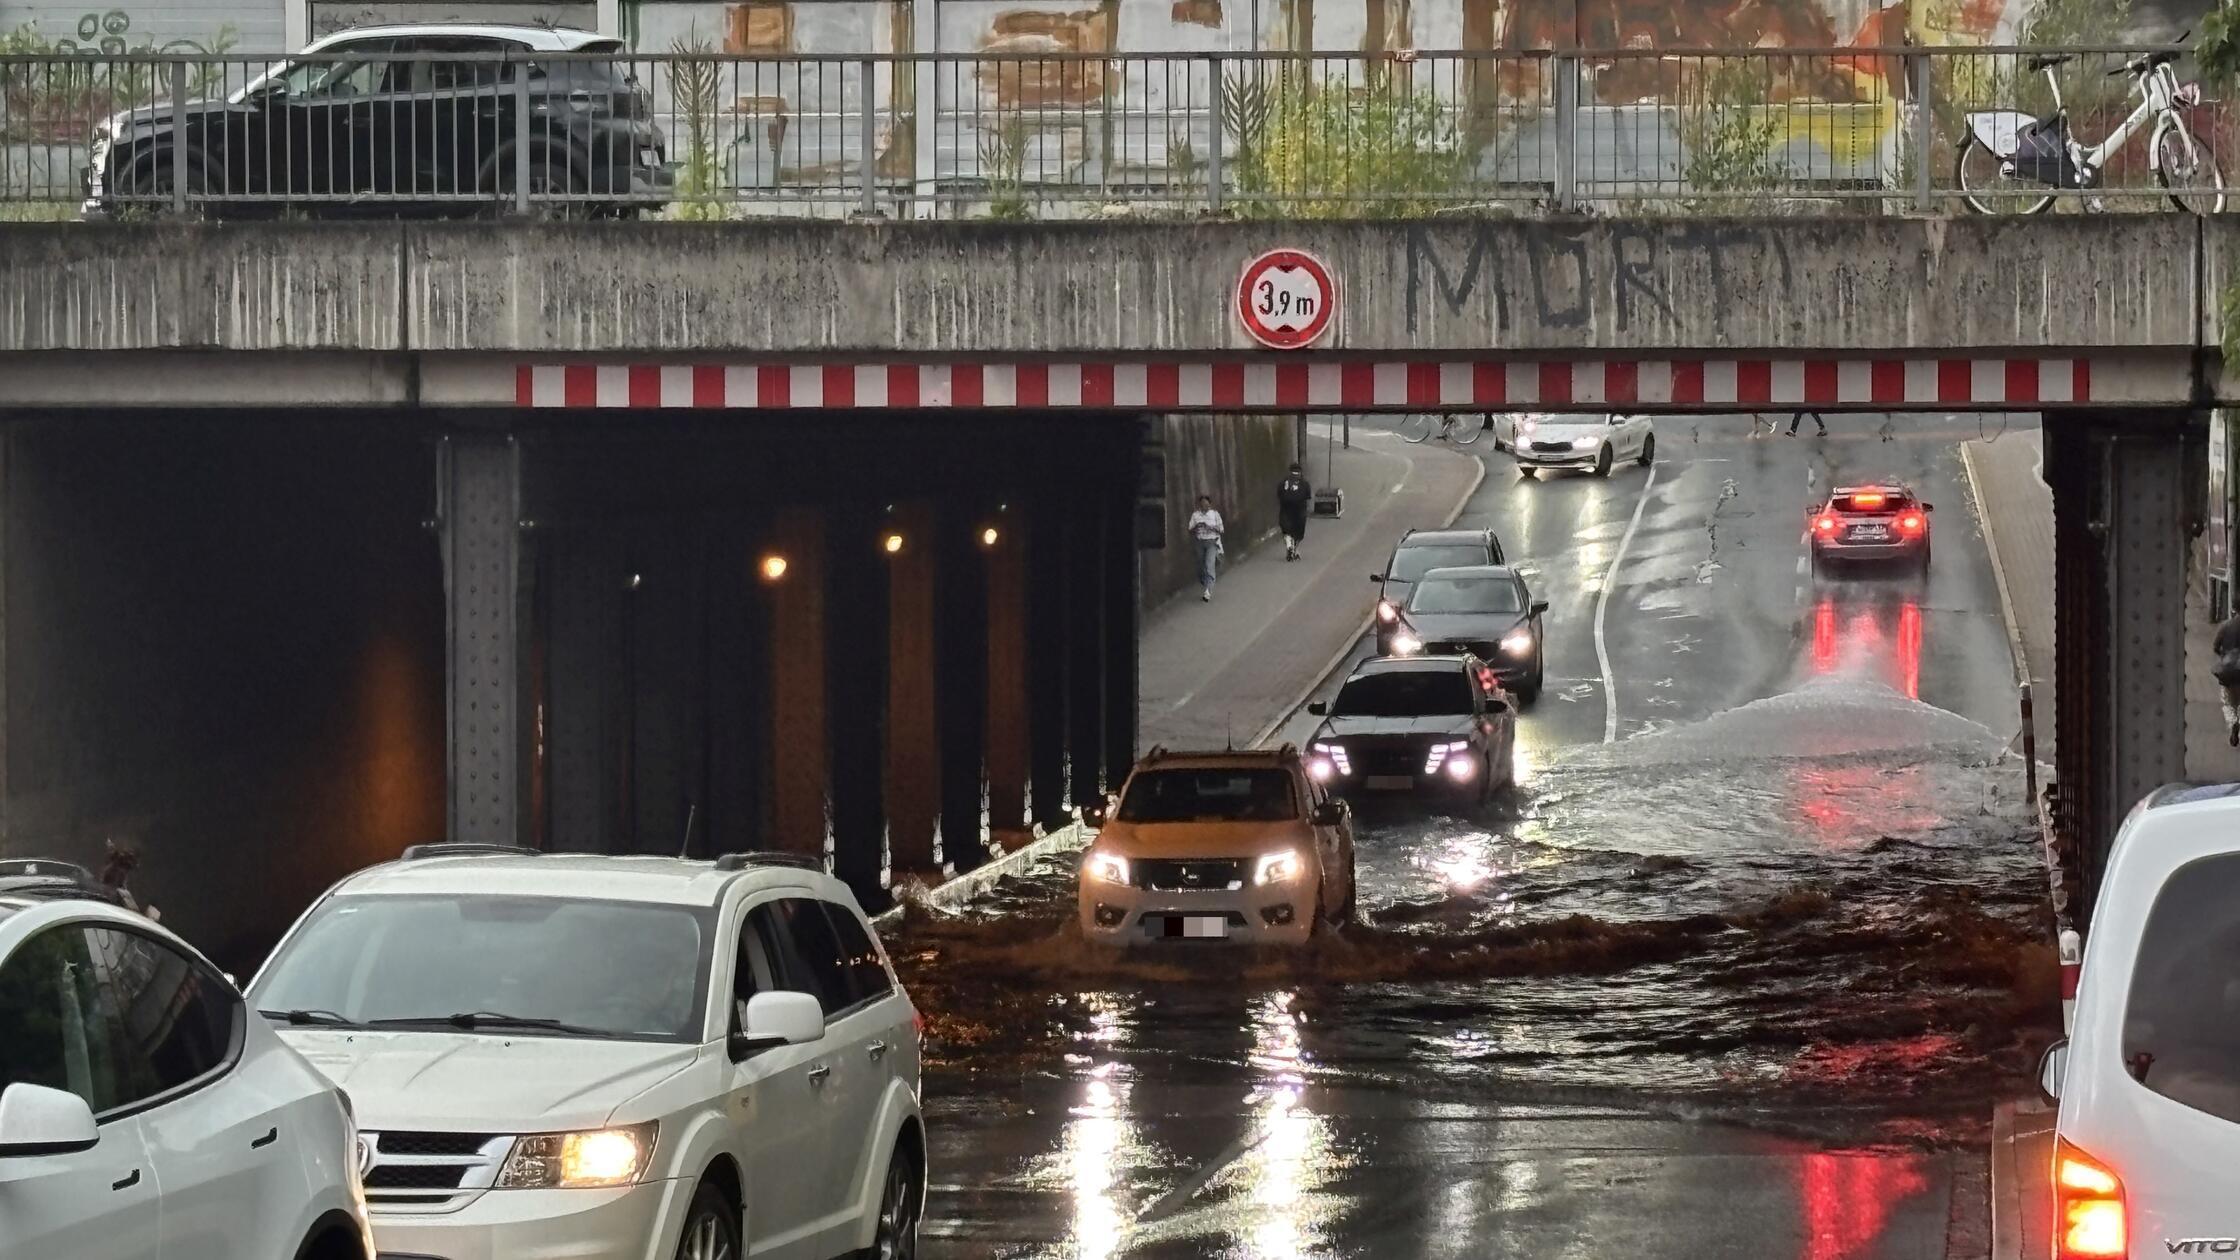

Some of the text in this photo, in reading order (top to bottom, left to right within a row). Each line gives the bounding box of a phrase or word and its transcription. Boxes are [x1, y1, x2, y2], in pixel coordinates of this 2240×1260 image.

[1259, 280, 1314, 316] 3,9 m
[2164, 1238, 2238, 1254] VITO
